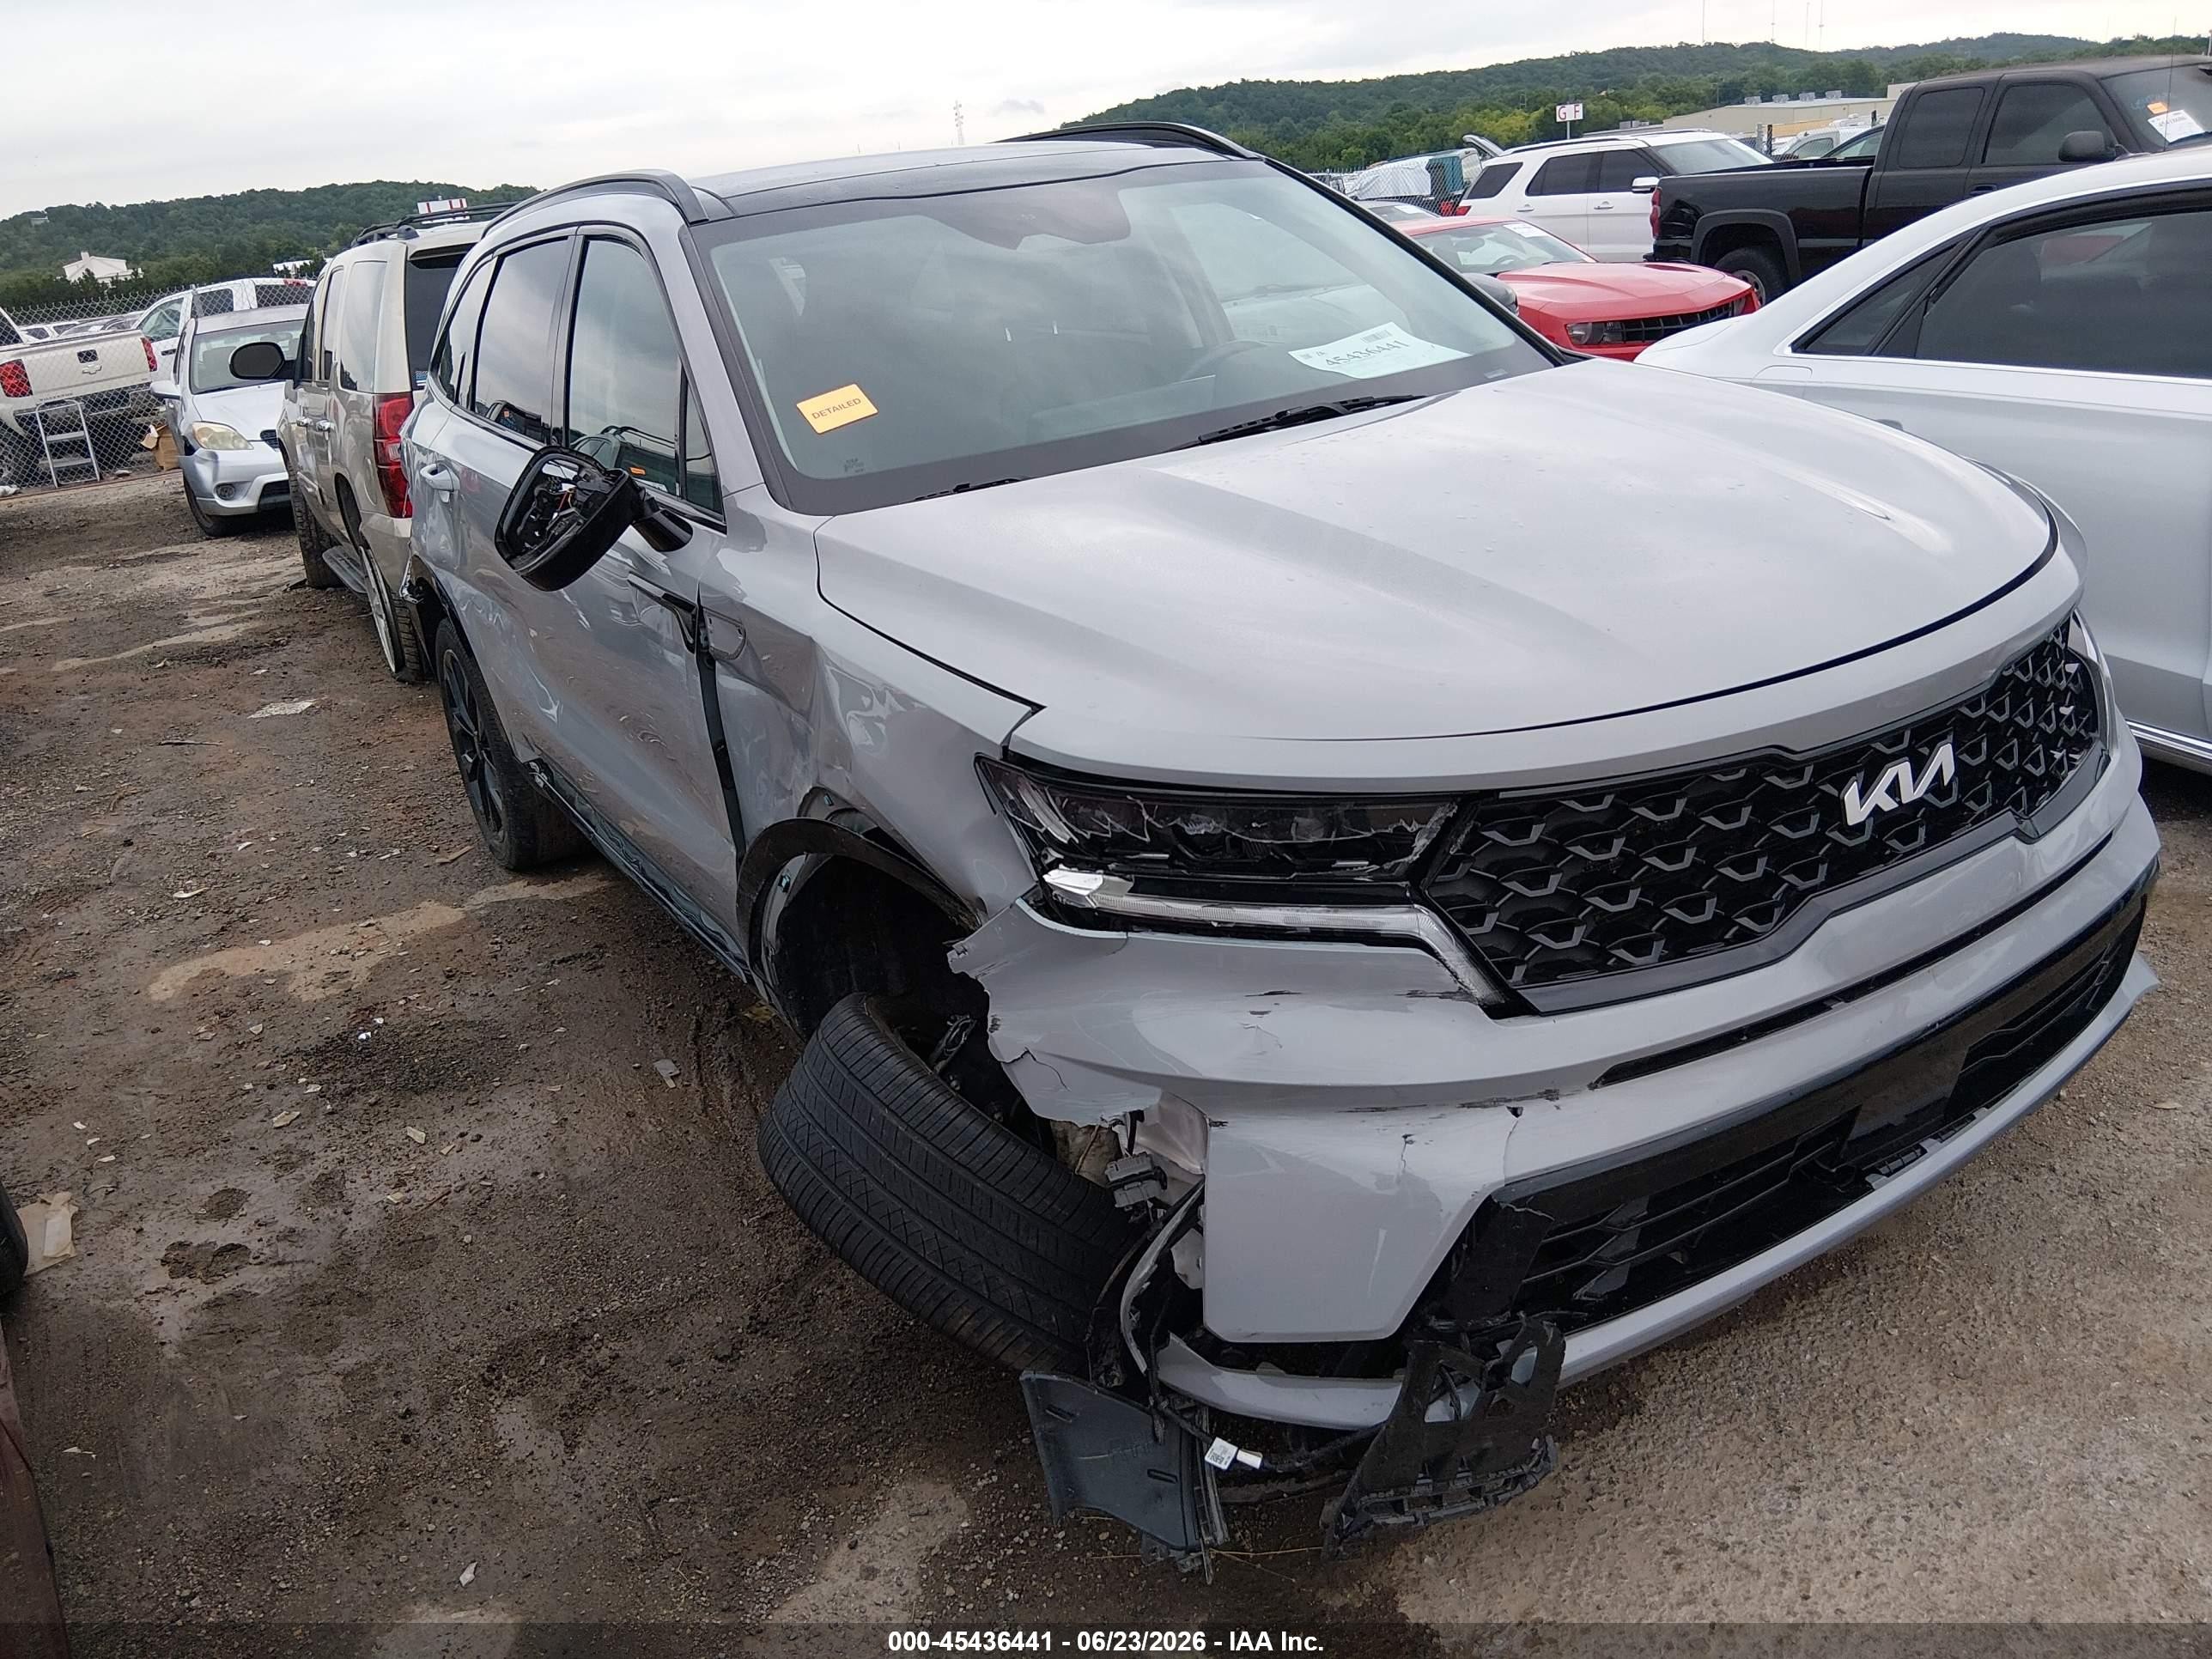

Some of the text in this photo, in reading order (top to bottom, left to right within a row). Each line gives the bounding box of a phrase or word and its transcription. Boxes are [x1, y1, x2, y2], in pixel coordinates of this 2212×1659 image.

[1559, 104, 1580, 120] G F
[1325, 339, 1409, 368] 45436441
[811, 397, 861, 420] DETAILED
[1844, 743, 1955, 826] KIA
